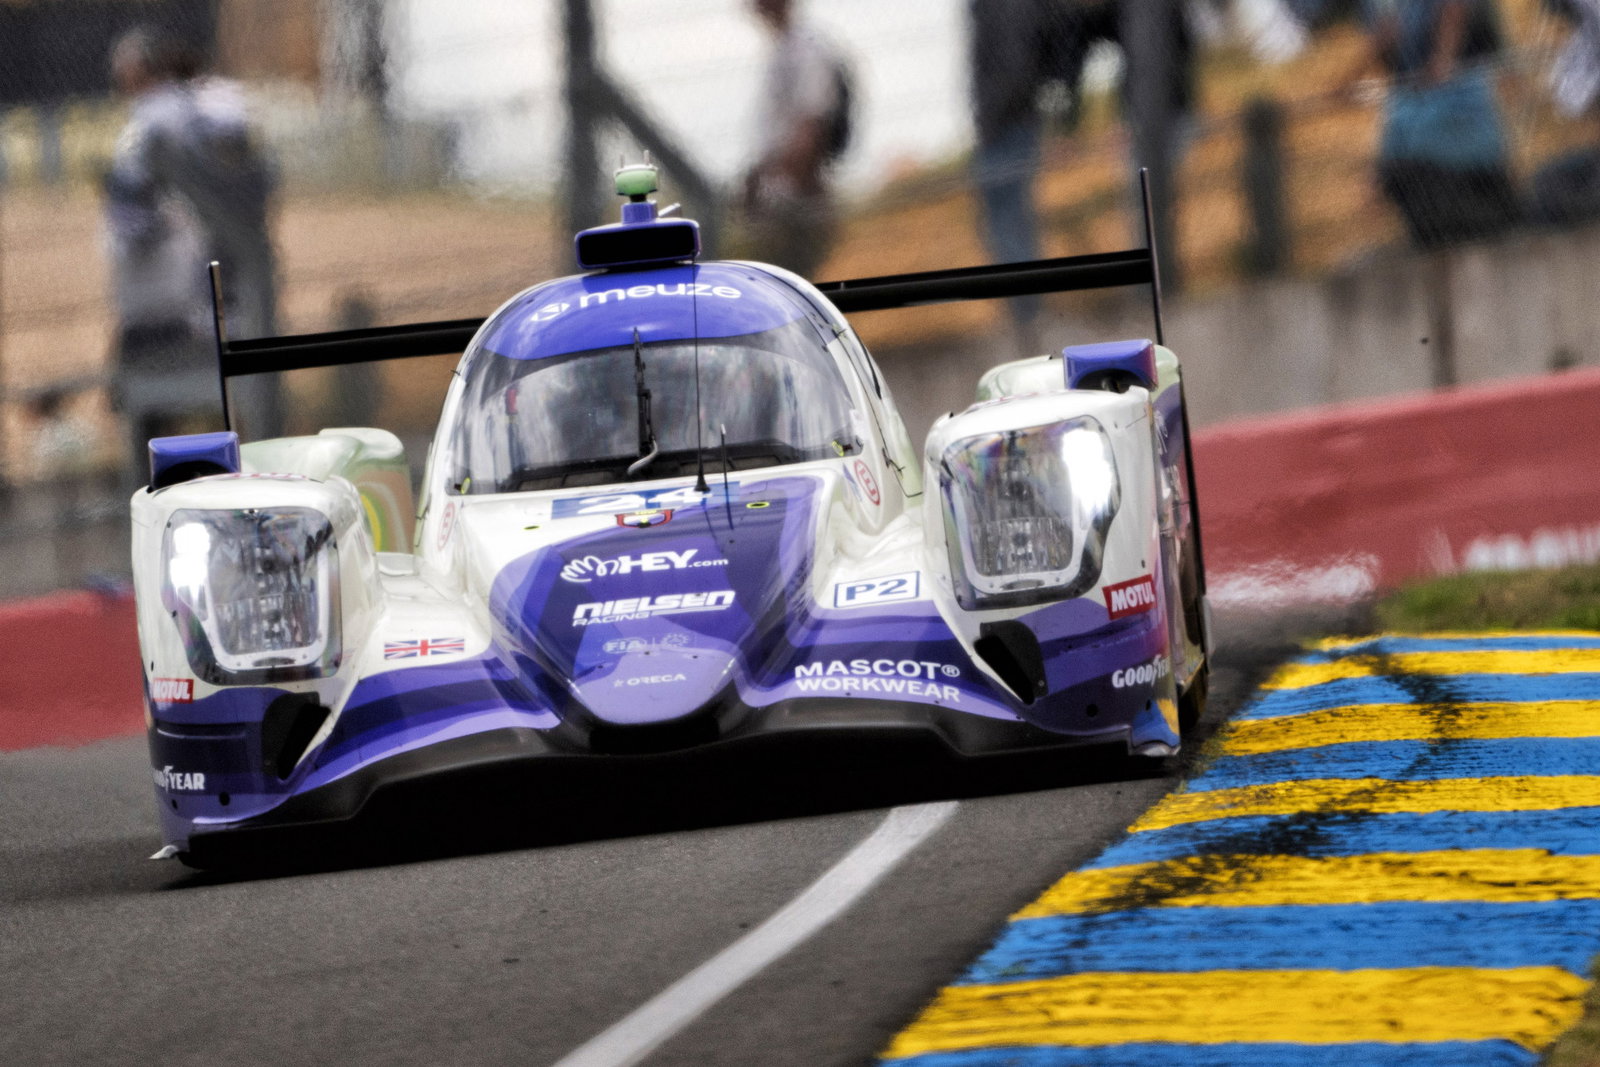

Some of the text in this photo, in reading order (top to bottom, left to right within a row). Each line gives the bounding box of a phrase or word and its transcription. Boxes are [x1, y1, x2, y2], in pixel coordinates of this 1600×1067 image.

[579, 283, 742, 308] meuze
[577, 486, 713, 514] 24
[845, 578, 908, 601] P2
[1111, 582, 1155, 613] MOTUL
[573, 590, 736, 619] NIELSEN
[572, 611, 649, 627] RACING
[604, 639, 642, 653] FIA
[627, 673, 687, 686] ORECA
[795, 678, 961, 702] WORKWEAR
